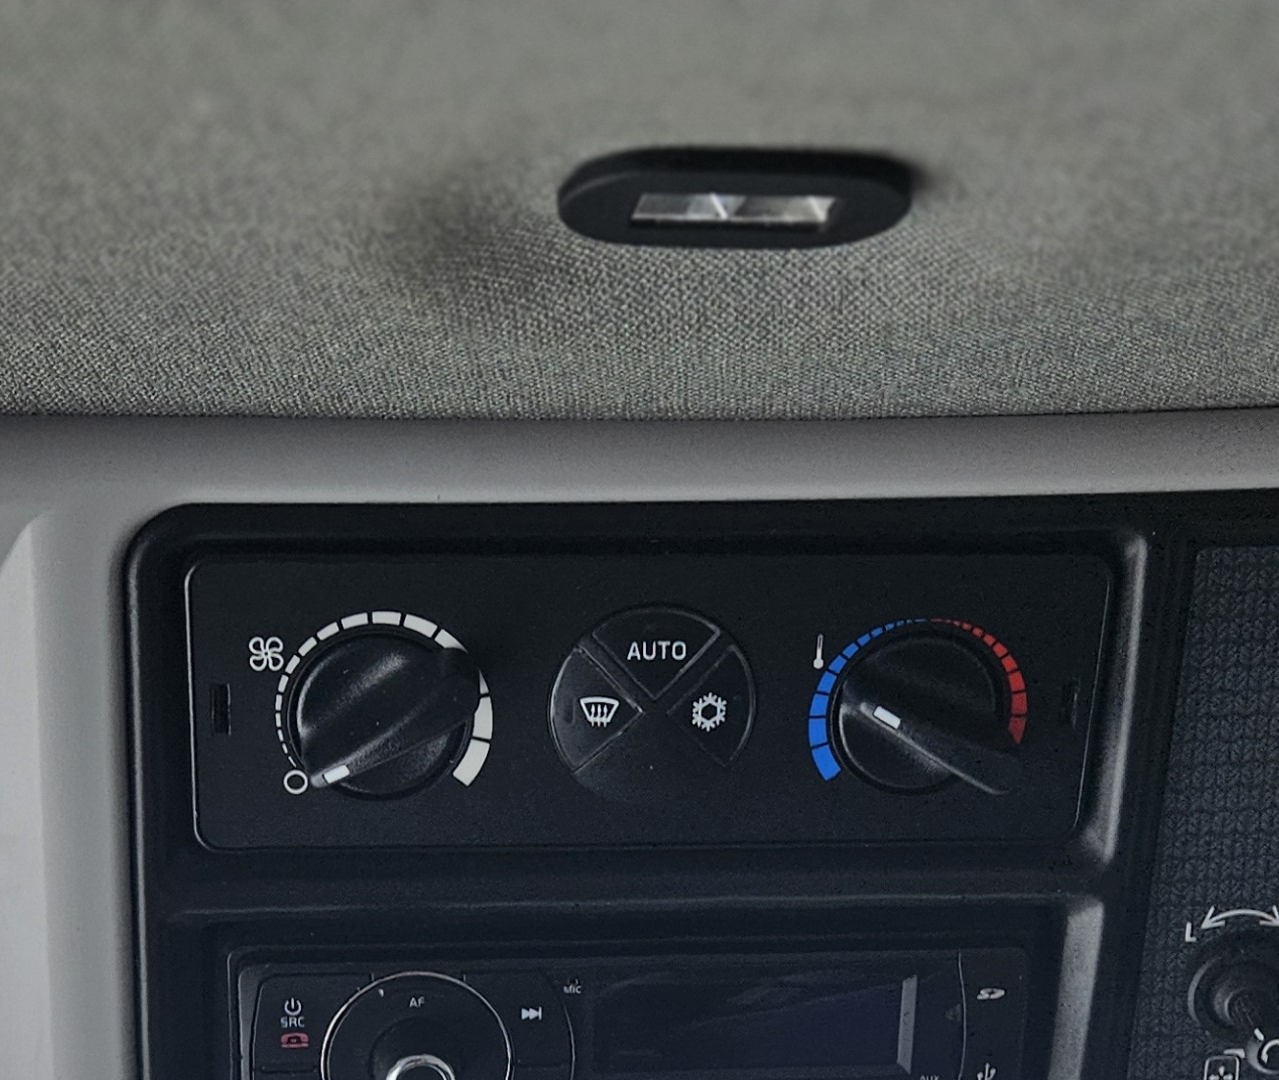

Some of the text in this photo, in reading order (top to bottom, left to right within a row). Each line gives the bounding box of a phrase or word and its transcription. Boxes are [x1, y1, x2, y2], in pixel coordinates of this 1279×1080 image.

[626, 640, 687, 661] AUTO
[1184, 921, 1197, 943] L
[562, 984, 582, 995] MIC
[409, 996, 426, 1008] AF
[280, 1015, 306, 1029] SRC
